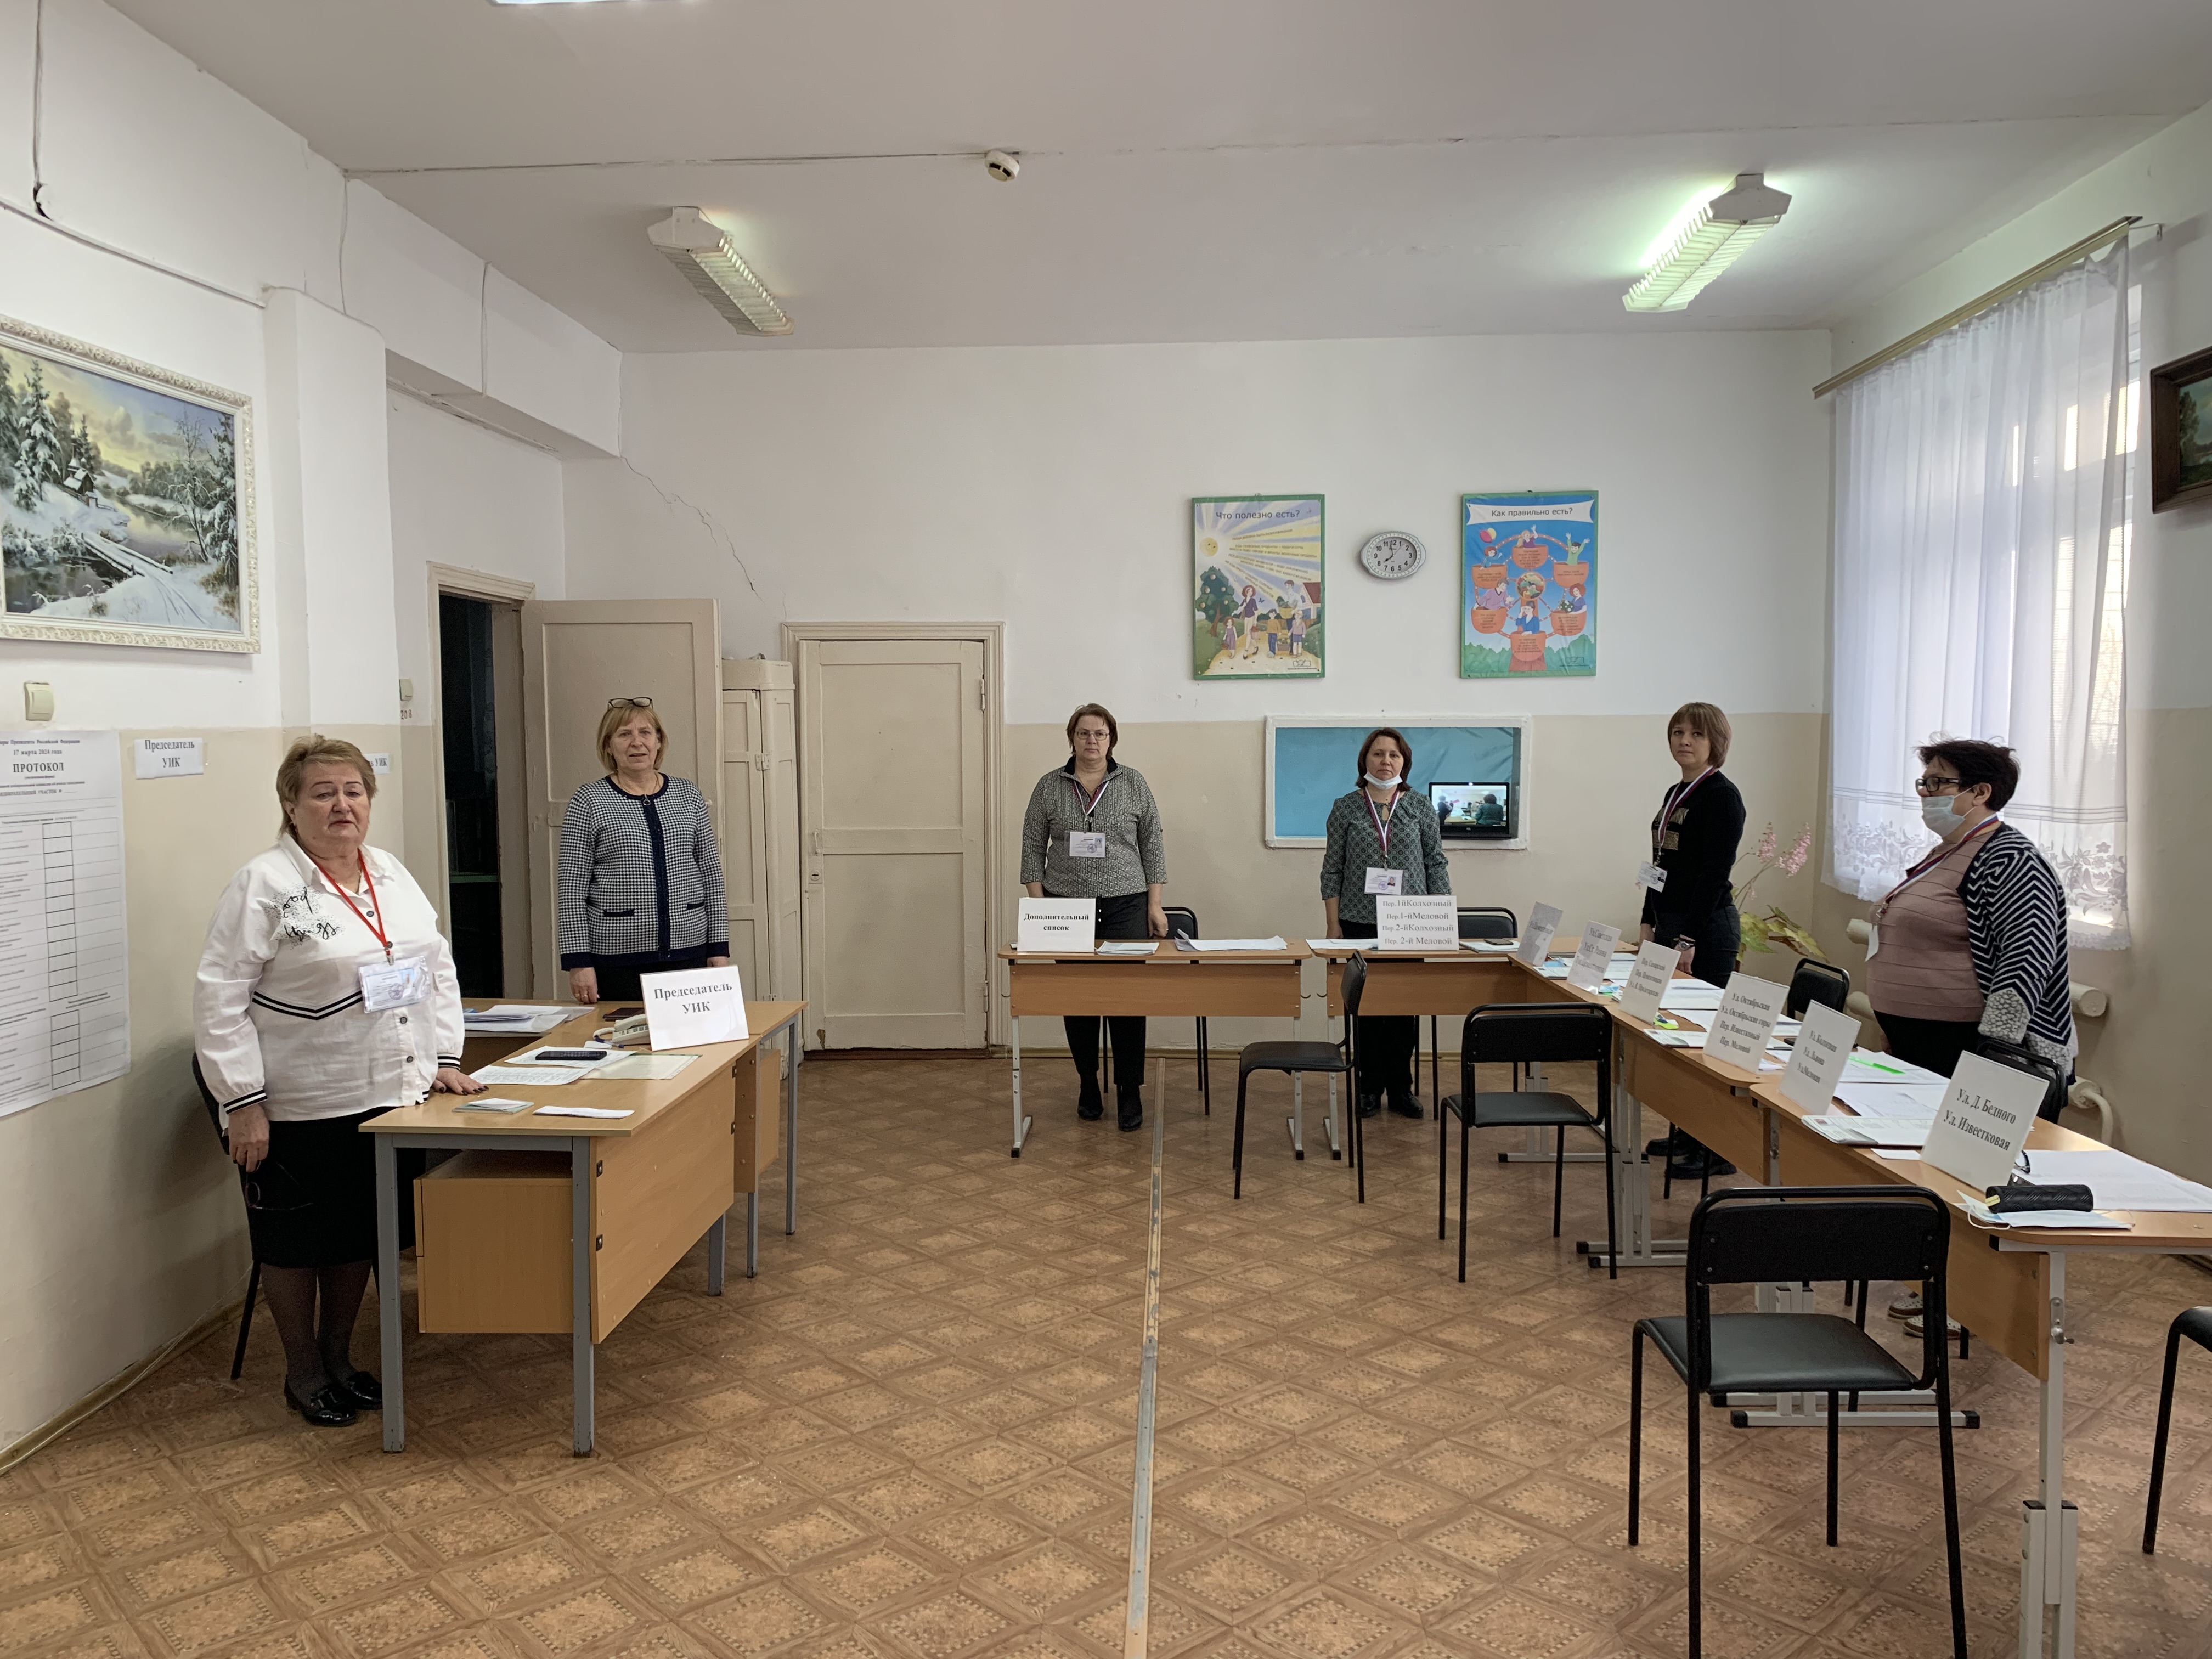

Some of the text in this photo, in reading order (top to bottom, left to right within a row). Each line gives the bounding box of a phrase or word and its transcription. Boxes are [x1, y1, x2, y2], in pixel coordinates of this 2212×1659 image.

[1216, 511, 1232, 520] Что
[1276, 510, 1300, 518] есть?
[1508, 509, 1549, 517] правильно
[144, 739, 195, 752] Председатель
[13, 762, 64, 772] ПРОТОКОЛ
[162, 757, 181, 768] УИК
[375, 758, 387, 766] УИК
[653, 984, 732, 1001] Председатель
[682, 1001, 710, 1014] УИК
[1956, 1088, 2016, 1124] Ул. Д. Бедного
[1943, 1110, 2011, 1151] Ул. Известковая
